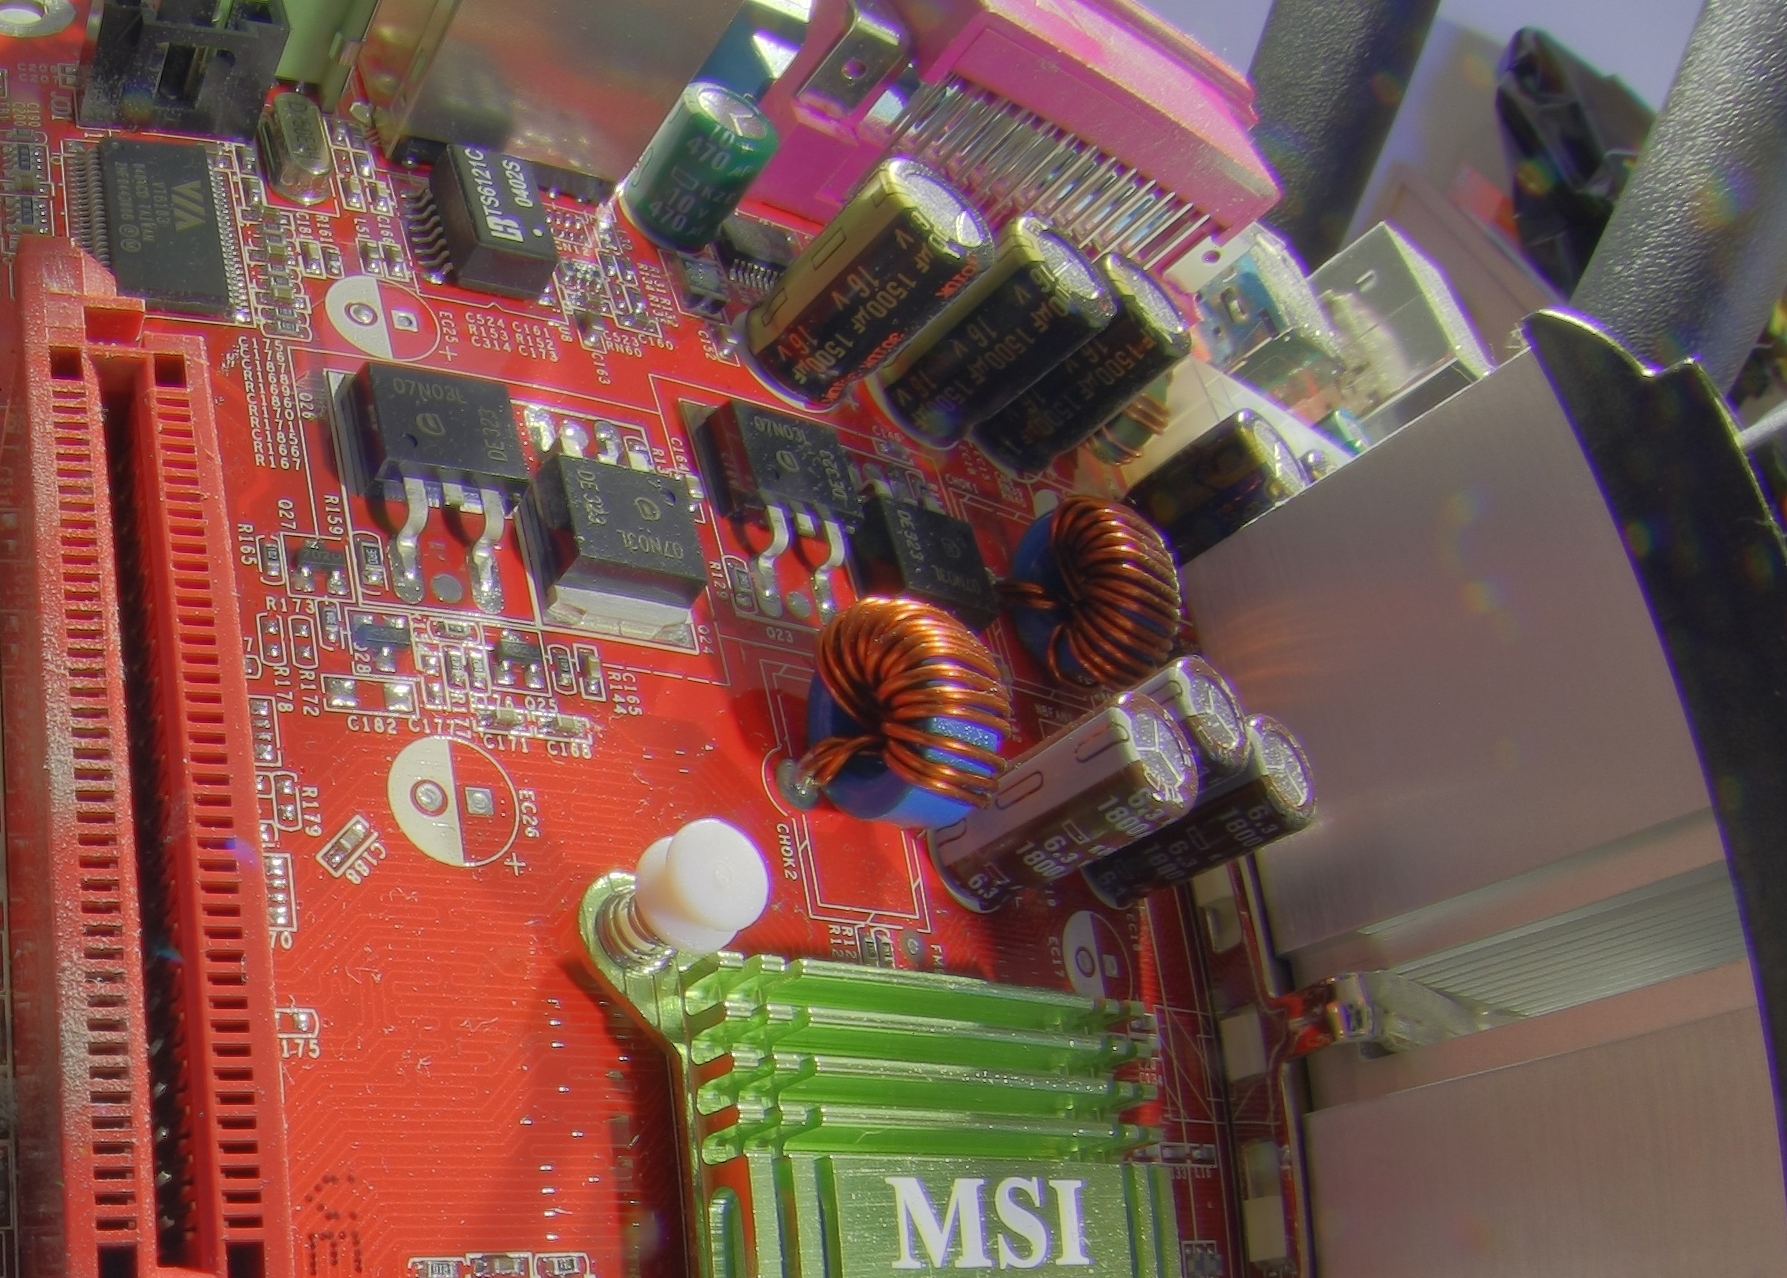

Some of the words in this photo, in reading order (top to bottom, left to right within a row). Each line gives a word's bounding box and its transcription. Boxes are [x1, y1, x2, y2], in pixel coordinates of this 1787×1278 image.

[464, 146, 504, 224] TS6121C
[502, 159, 534, 208] 0402S
[647, 198, 689, 232] 470
[468, 325, 509, 342] R153
[470, 337, 512, 353] C314
[323, 494, 344, 536] R159
[236, 522, 258, 566] R165
[265, 598, 316, 614] R173
[274, 664, 294, 713] R178
[299, 670, 320, 718] R172
[347, 717, 398, 736] C182
[482, 736, 530, 754] C171
[301, 785, 323, 839] R179
[518, 788, 541, 839] EC26
[774, 823, 799, 882] CHOK2
[1042, 834, 1079, 865] 6.3
[886, 1175, 1092, 1270] MSI
